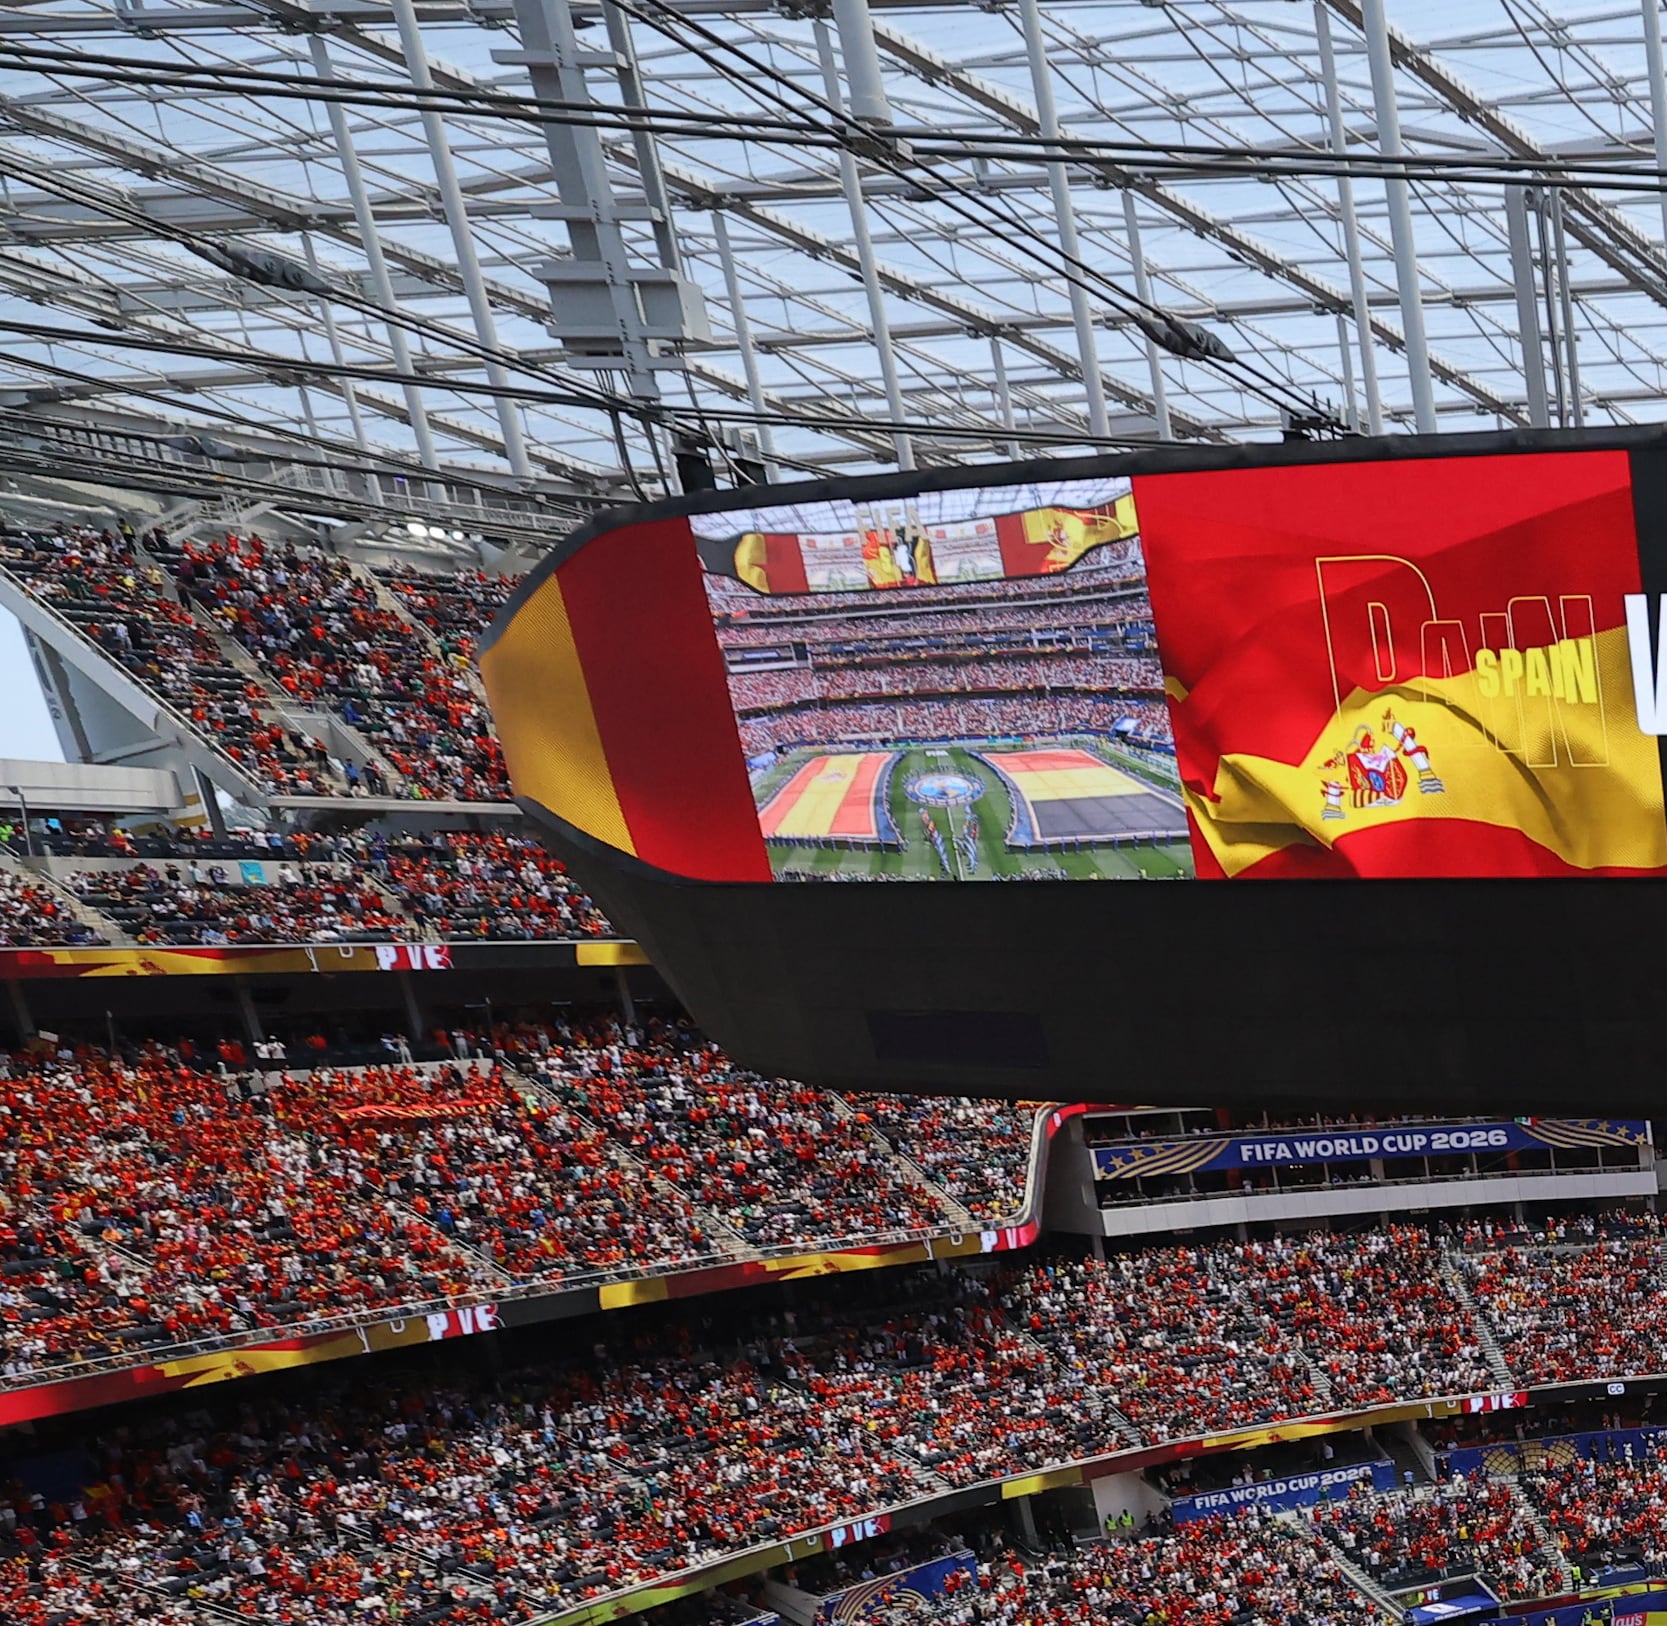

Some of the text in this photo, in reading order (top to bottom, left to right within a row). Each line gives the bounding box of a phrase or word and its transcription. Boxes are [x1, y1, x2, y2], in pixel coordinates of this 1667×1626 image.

[1474, 637, 1599, 704] SPAIN
[1240, 1128, 1509, 1161] FIFA WORLD CUP 2026
[1195, 1487, 1231, 1510] FIFA
[1230, 1478, 1287, 1500] WORLD
[1288, 1472, 1320, 1492] CUP
